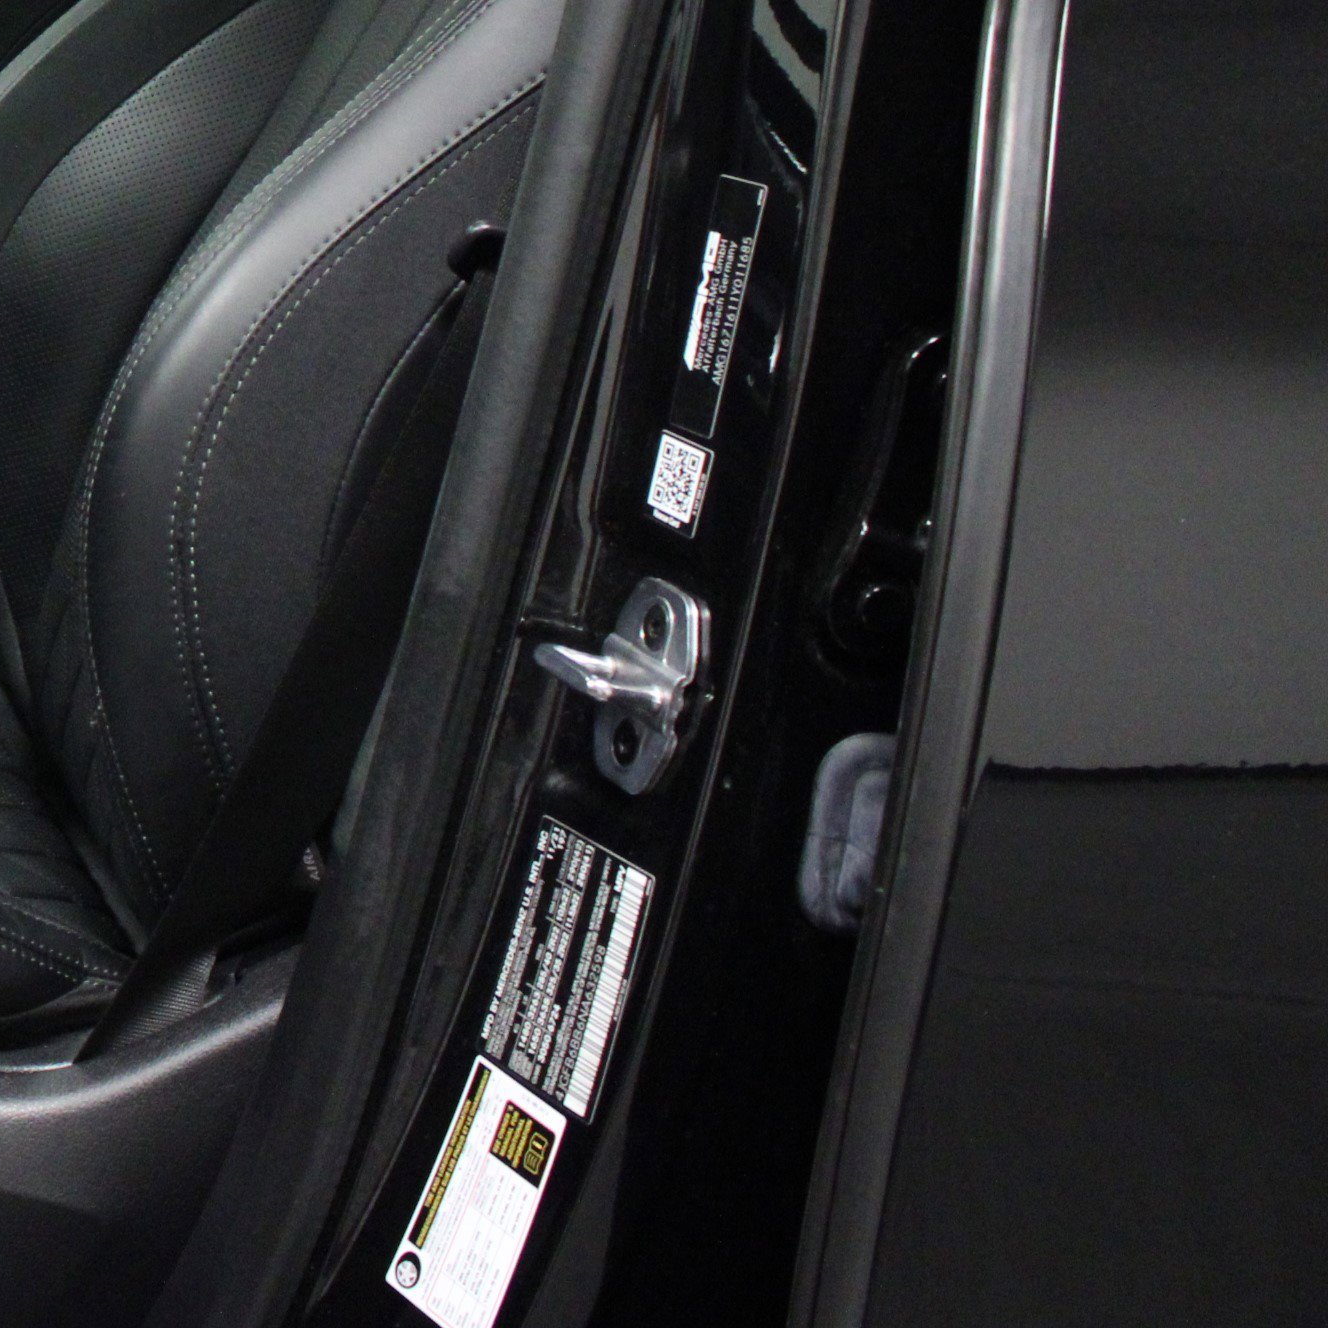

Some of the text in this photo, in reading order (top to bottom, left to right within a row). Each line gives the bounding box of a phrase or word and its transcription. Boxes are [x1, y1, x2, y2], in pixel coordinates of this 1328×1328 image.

[692, 236, 729, 371] Mercedes-AMG GmbH
[700, 239, 738, 374] Affalterbach Germany
[611, 862, 627, 894] MPV
[488, 995, 500, 1014] BY
[493, 905, 528, 998] MERCEDES-BENZ
[553, 942, 607, 1104] 4JGFB6BB6NA632598
